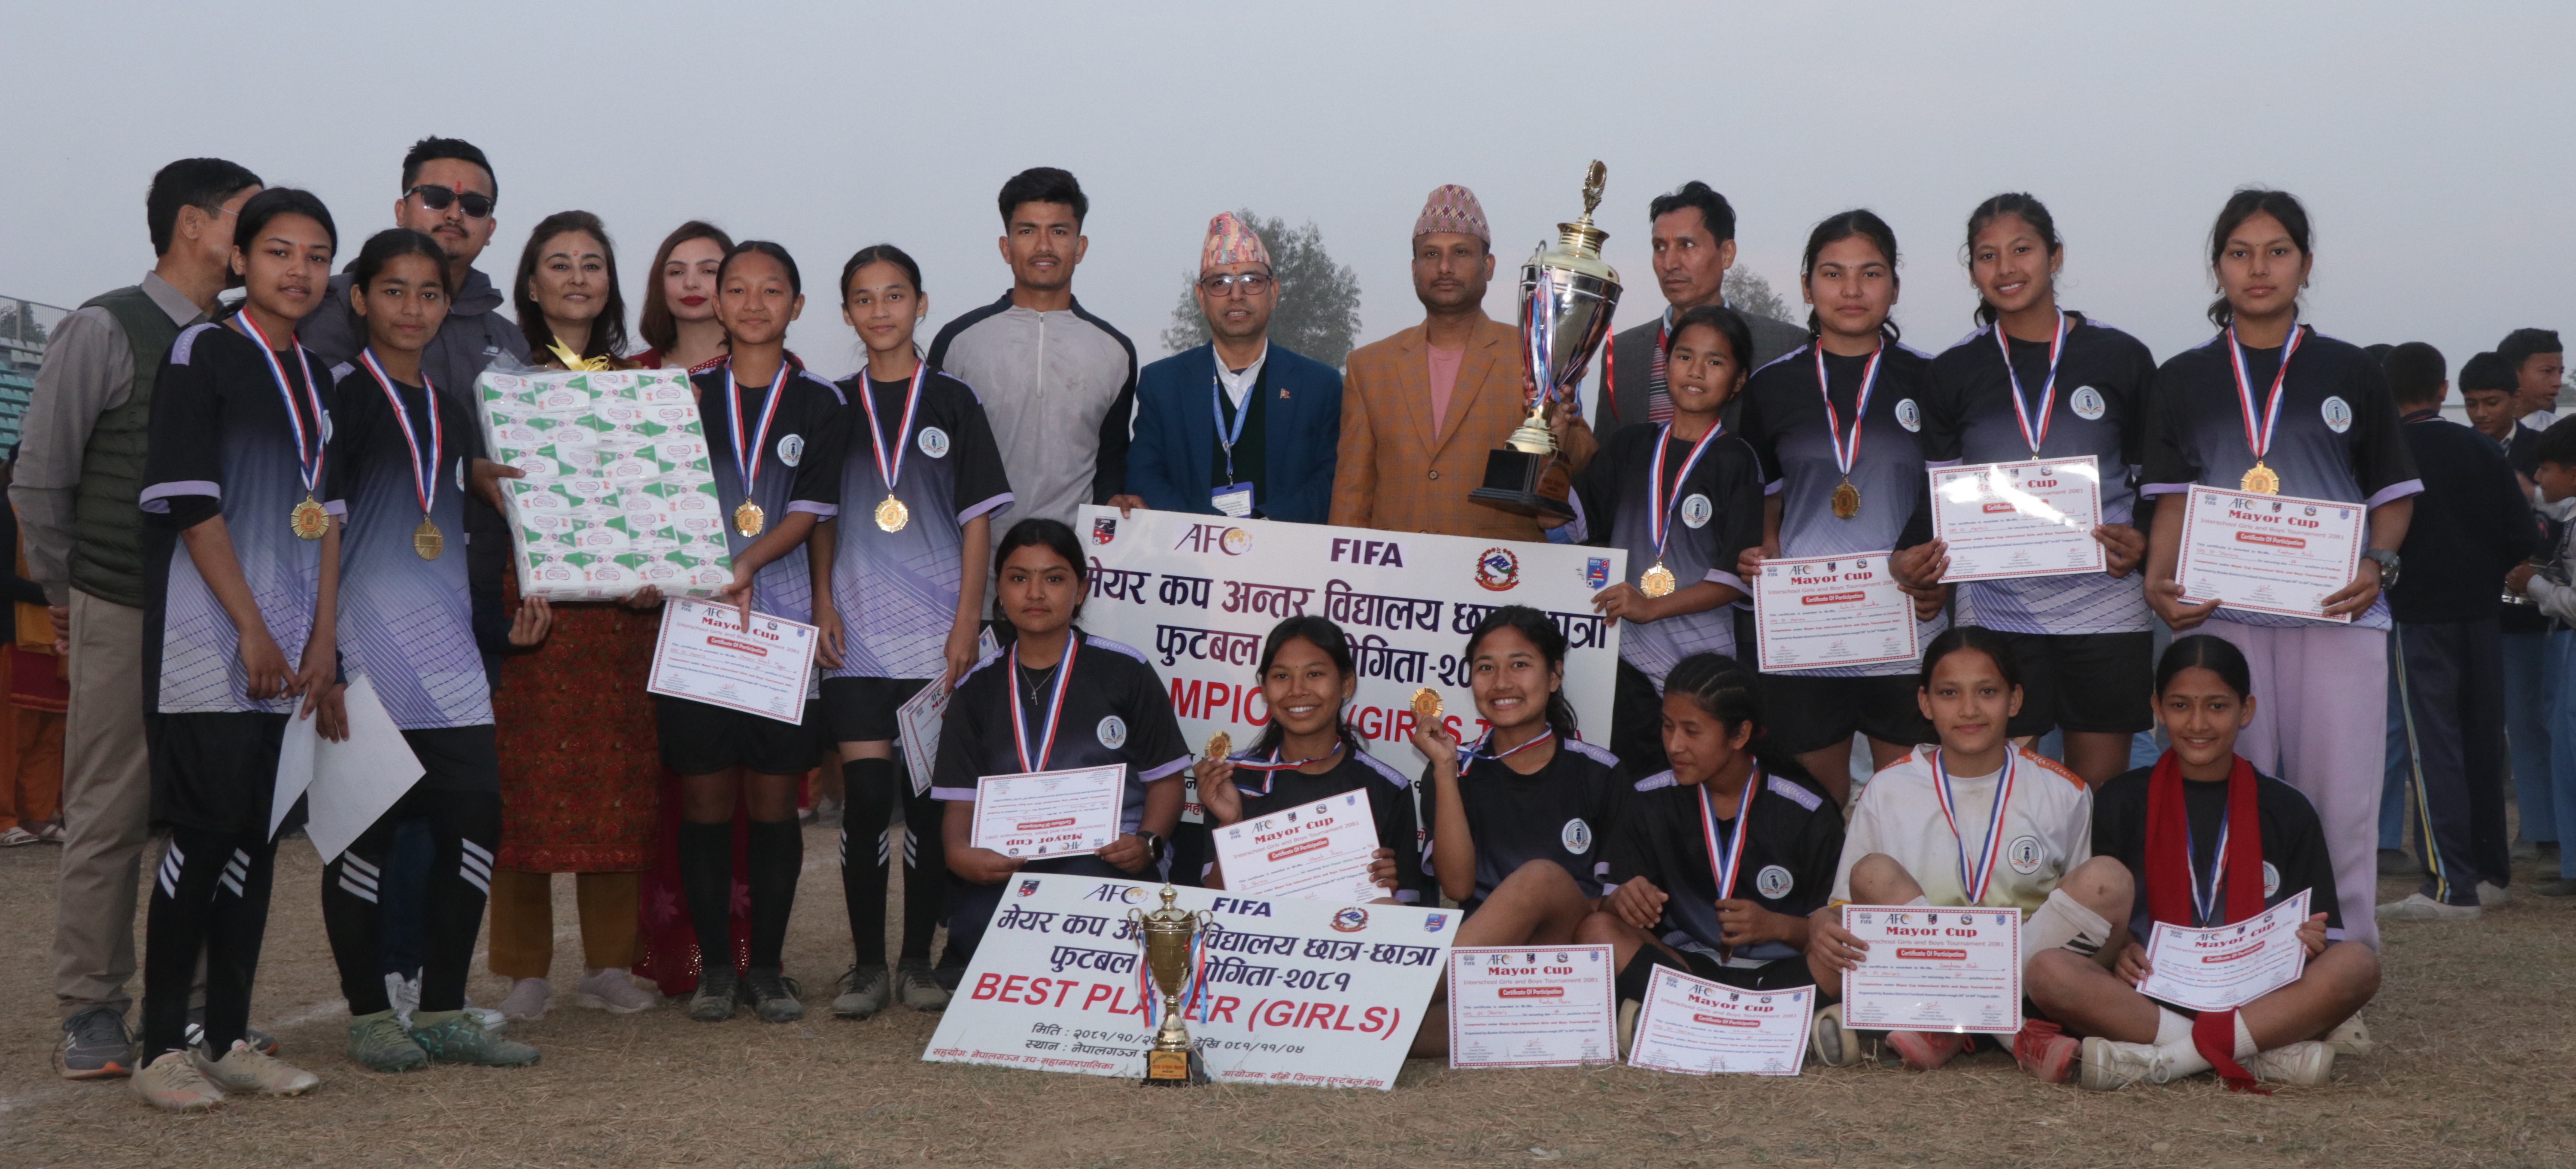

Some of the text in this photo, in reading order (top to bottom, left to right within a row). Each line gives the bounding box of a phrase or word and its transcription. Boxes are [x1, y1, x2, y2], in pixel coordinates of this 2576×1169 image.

[2028, 479, 2057, 488] Cup
[2228, 498, 2255, 510] AFC
[2200, 518, 2236, 527] Interschool
[2229, 510, 2319, 528] Mayor Cup
[1174, 524, 1247, 556] AFC
[2273, 538, 2303, 546] Participation
[1331, 538, 1403, 567] FIFA
[1789, 565, 1812, 575] AFC
[1791, 572, 1872, 585] Mayor Cup
[1159, 574, 1213, 609] कप
[1221, 580, 1315, 619] अन्तर
[1323, 578, 1443, 632] विद्यालय
[702, 608, 725, 618] AFC
[677, 622, 708, 632] Interschool
[752, 638, 785, 650] Tournament
[702, 617, 780, 641] Mayo Cup
[711, 638, 733, 646] Certificate
[739, 643, 766, 654] Participation
[1156, 624, 1262, 667] फुटबल
[1170, 677, 1271, 727] MPIO
[1346, 705, 1462, 746] (GIRS
[1252, 819, 1274, 834] AFC
[1255, 817, 1334, 844] Mayor Cup
[1234, 847, 1265, 859] Interschool
[1309, 826, 1343, 838] Tournament
[1272, 849, 1294, 858] Certificate
[1300, 840, 1327, 851] Participation
[1083, 883, 1145, 904] AFC
[1211, 897, 1271, 917] FIFA
[1885, 913, 1911, 924] AFC
[997, 904, 1059, 933] मेयर
[1062, 913, 1109, 937] कप
[1203, 922, 1299, 956] विद्यालय
[1303, 938, 1440, 966] छात्र-छात्रा
[1886, 927, 1977, 938] Mayor Cup
[1051, 946, 1138, 974] फुटबल
[1487, 954, 1510, 965] AFC
[1488, 966, 1573, 976] Mayor Cup
[1688, 984, 1713, 997] AFC
[971, 973, 1400, 1040] BEST PLAER (GIRLS)
[1661, 998, 1695, 1009] Interschool
[1688, 994, 1739, 1010] Mayor
[1698, 1015, 1721, 1024] Certificate
[1031, 1023, 1063, 1036] मिति
[1224, 1041, 1305, 1053] ०८१/११/०४
[1026, 1039, 1061, 1050] स्थान
[1072, 1041, 1139, 1057] नेपालगञ्ज
[971, 1050, 1021, 1062] नेपालगञ्ज
[1022, 1056, 1115, 1070] उप-महानगरपालिका
[1270, 1069, 1291, 1080] बाँके
[1293, 1073, 1325, 1082] जिल्ला
[1367, 1077, 1385, 1087] संघ
